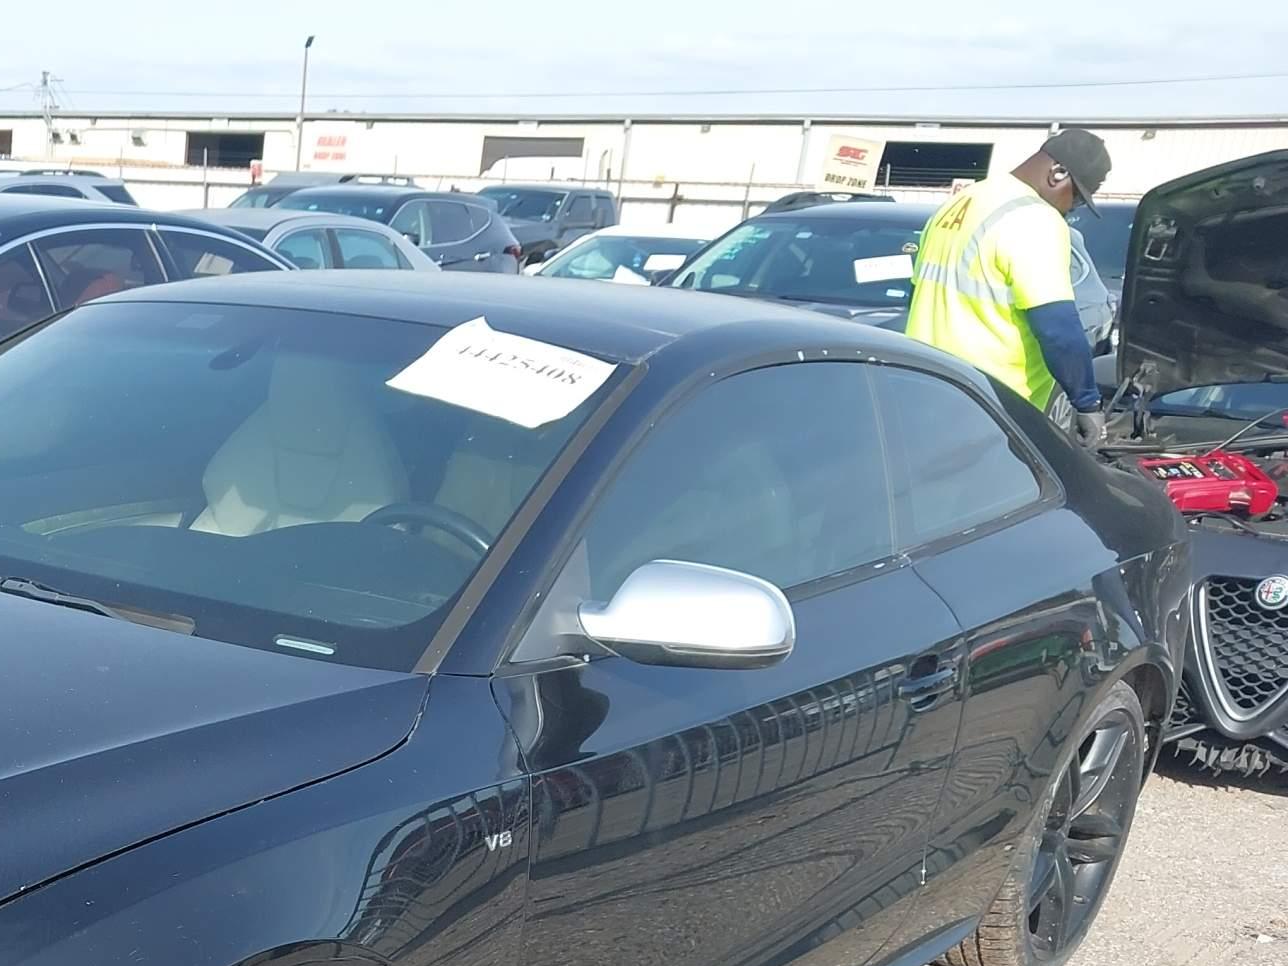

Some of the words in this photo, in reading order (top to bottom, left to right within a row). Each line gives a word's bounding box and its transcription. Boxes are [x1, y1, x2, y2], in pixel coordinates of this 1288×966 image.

[824, 173, 846, 184] DROP
[847, 176, 867, 188] ZONE
[485, 831, 512, 851] V8
